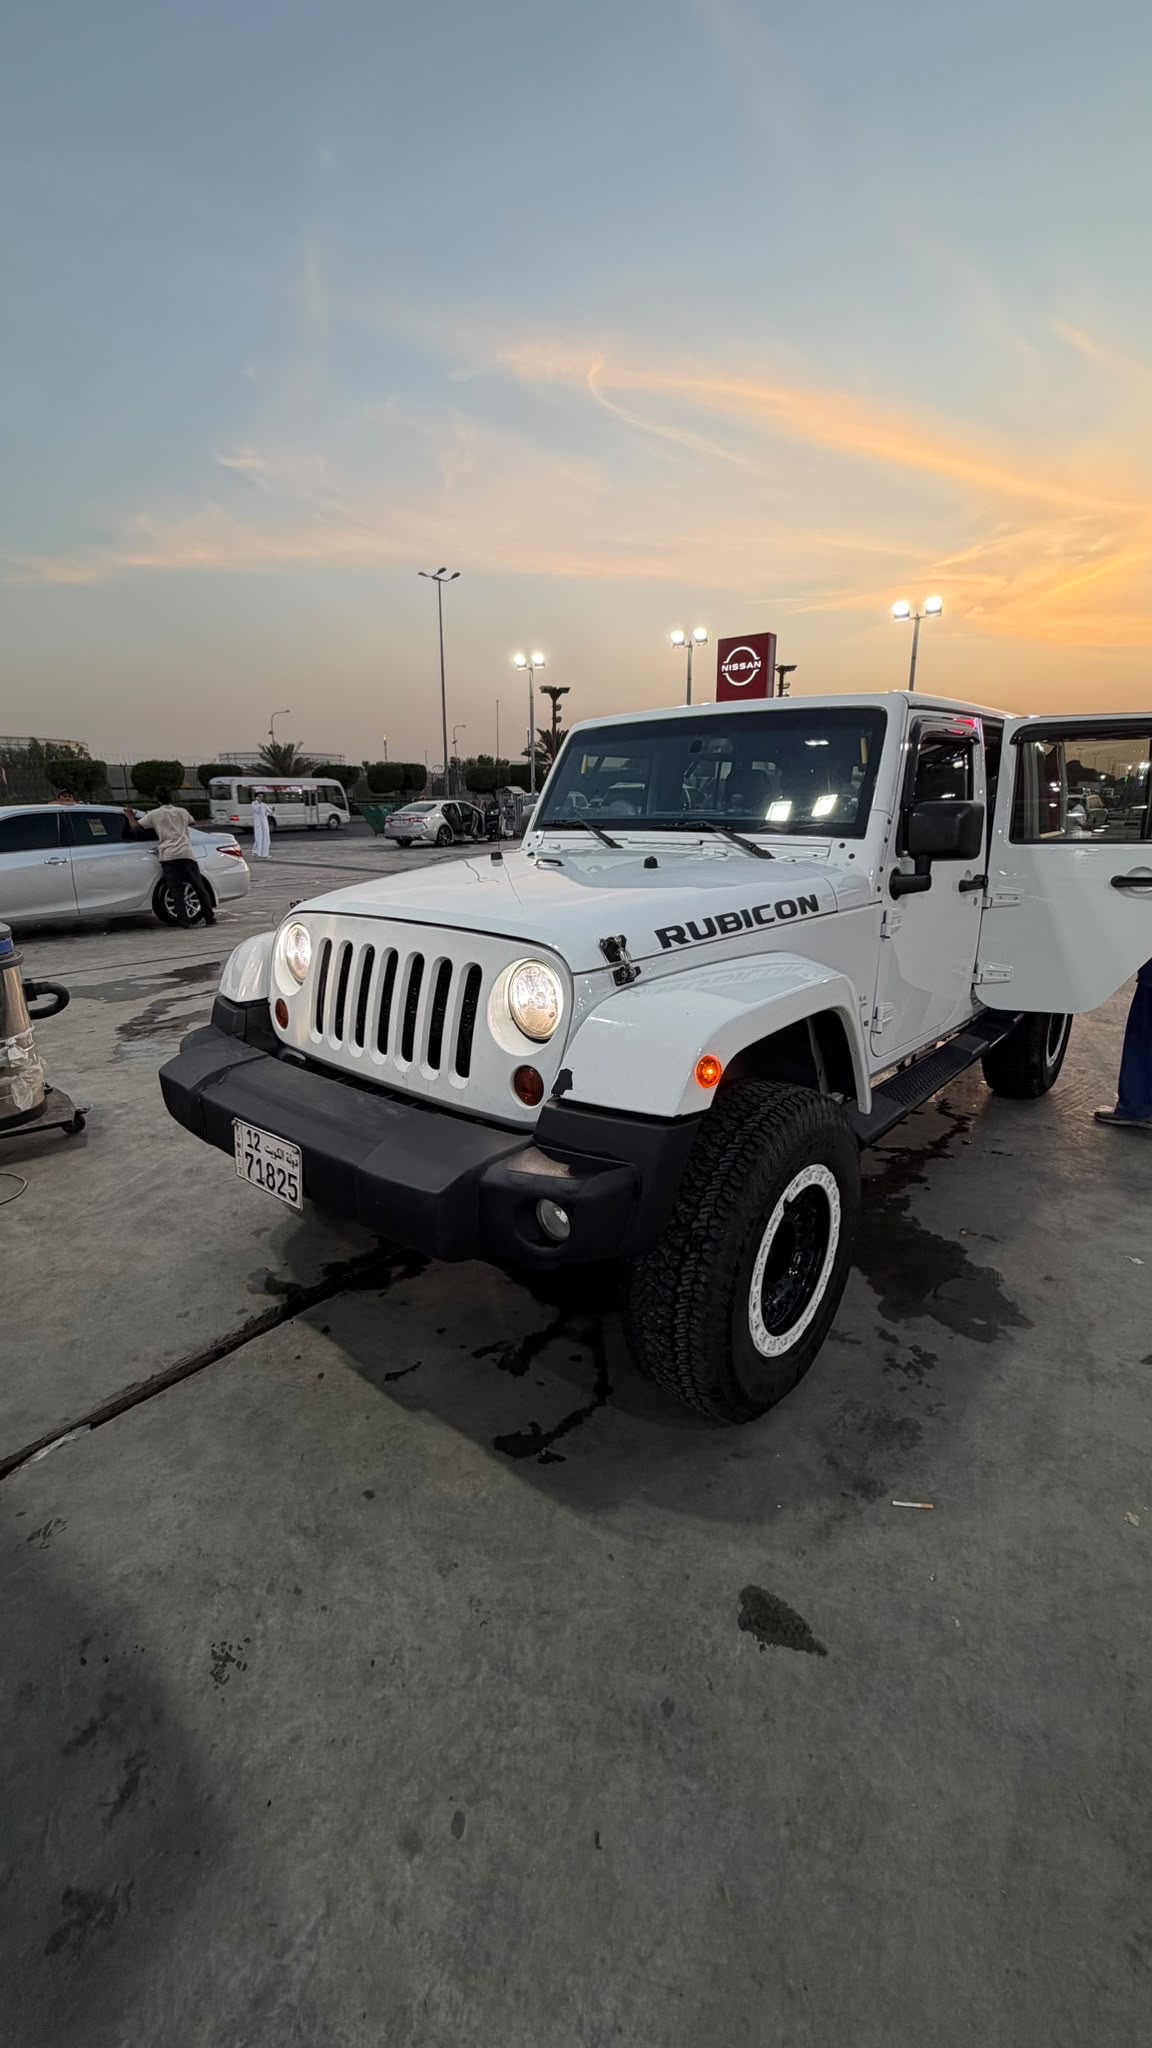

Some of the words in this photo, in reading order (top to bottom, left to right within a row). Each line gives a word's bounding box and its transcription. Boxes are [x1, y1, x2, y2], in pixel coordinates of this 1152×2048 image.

[721, 660, 762, 672] NISSAN
[654, 894, 819, 949] RUBICON
[247, 1130, 261, 1153] 12
[245, 1152, 298, 1201] 71825
